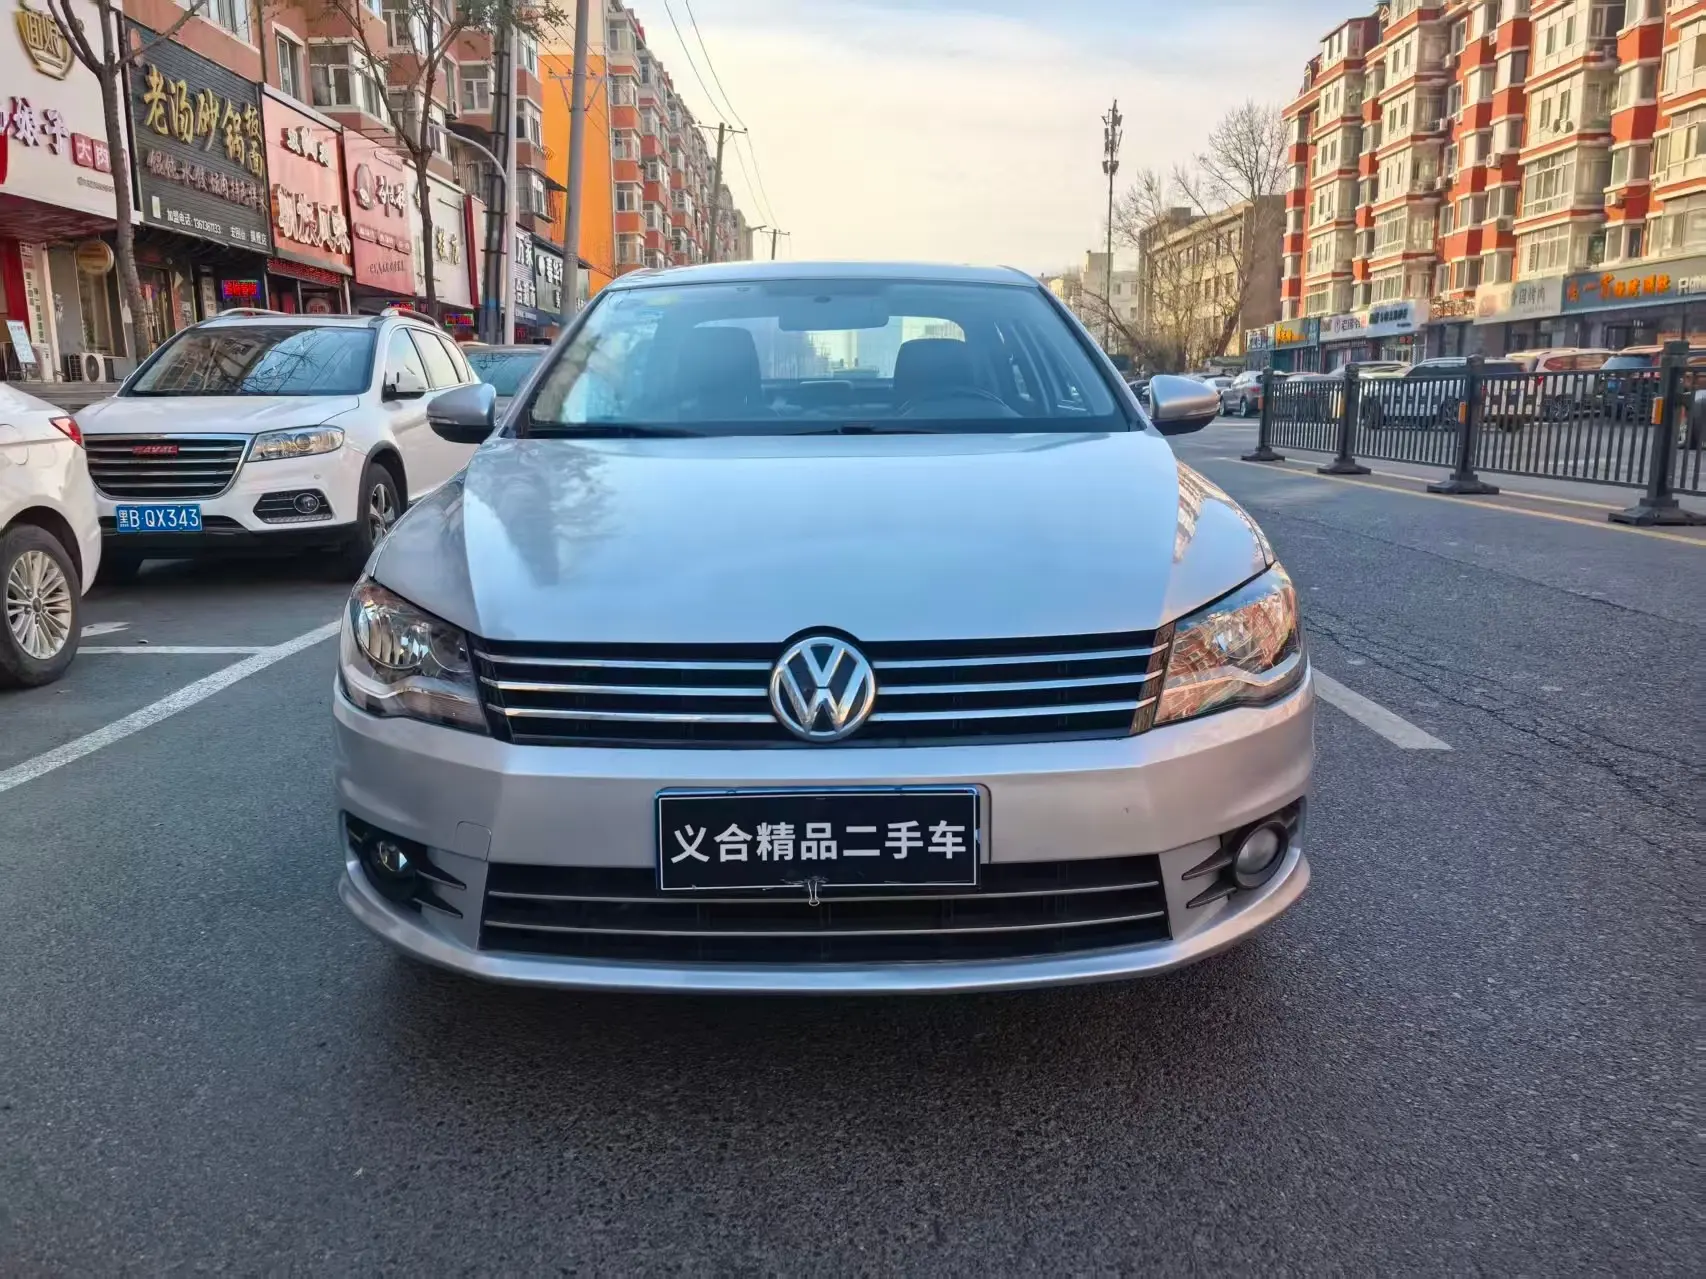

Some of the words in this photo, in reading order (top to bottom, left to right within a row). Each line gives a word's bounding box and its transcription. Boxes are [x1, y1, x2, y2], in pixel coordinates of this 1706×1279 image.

[0, 97, 70, 155] 娘子
[670, 820, 966, 863] 义合精品二手车
